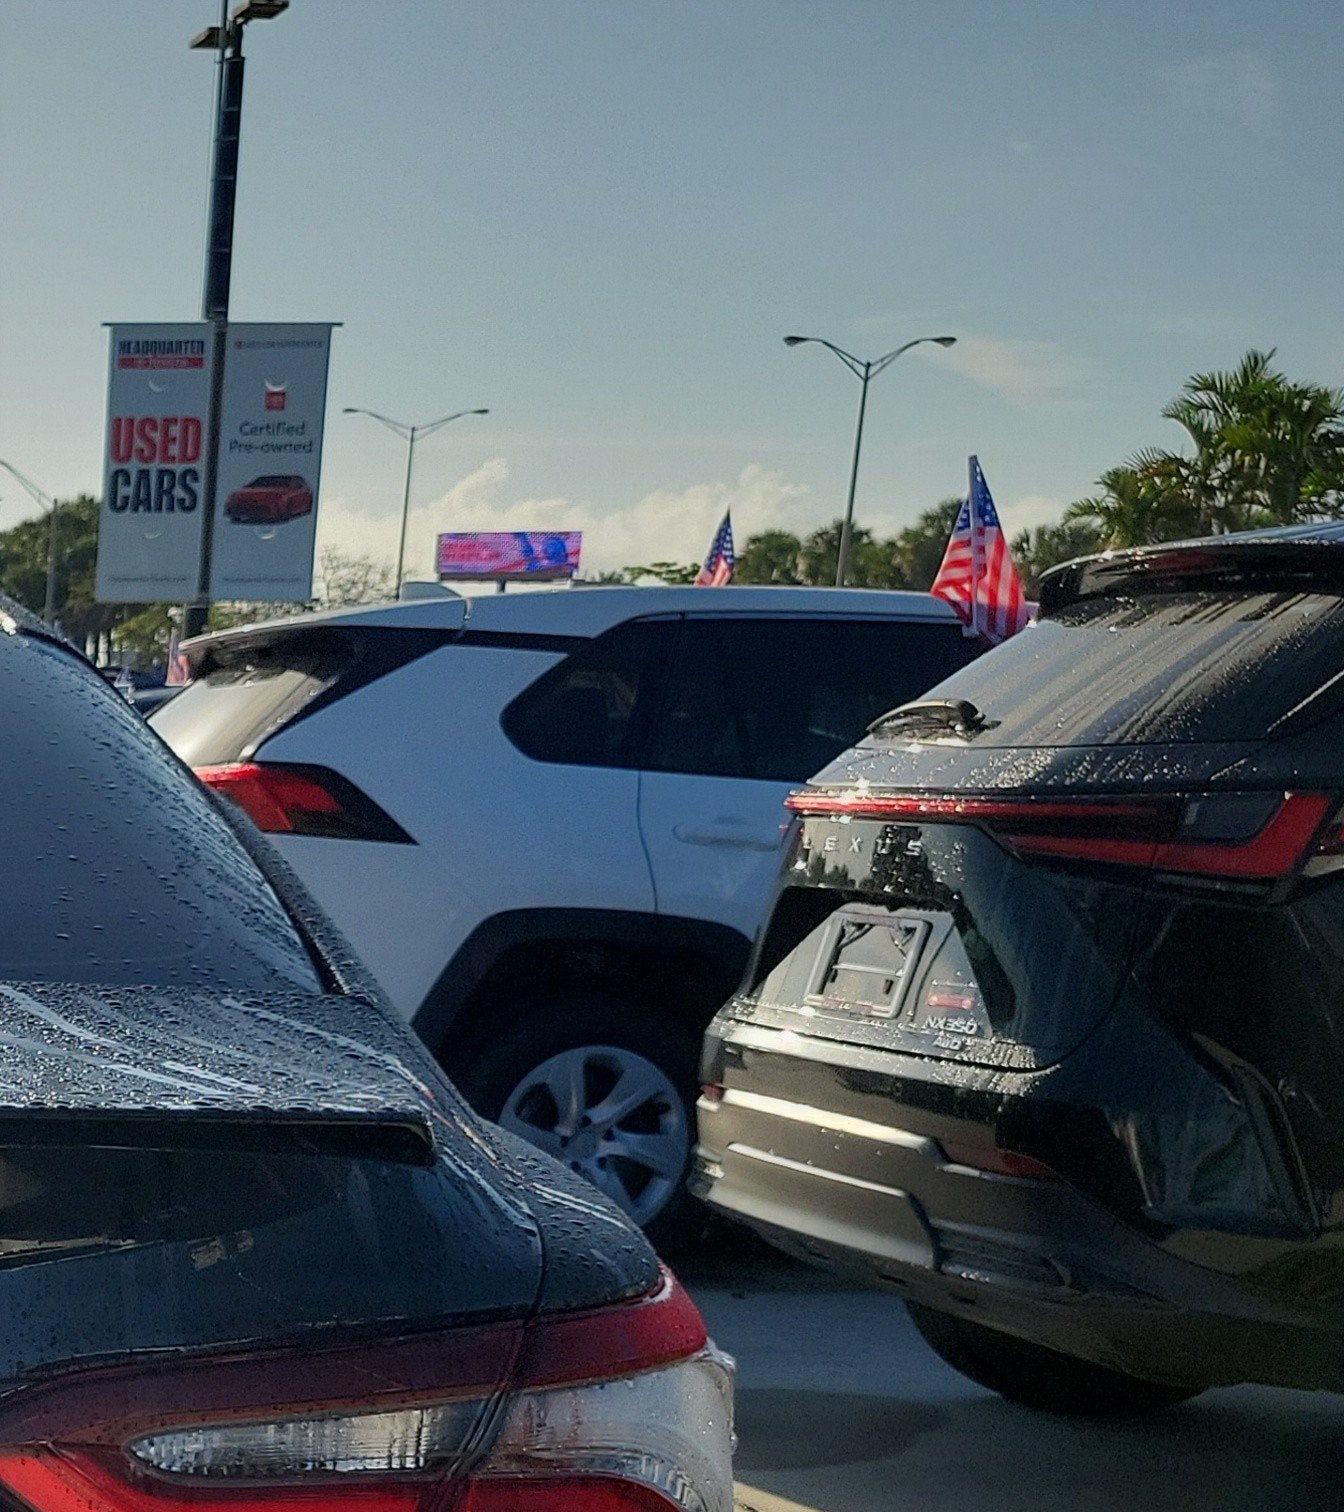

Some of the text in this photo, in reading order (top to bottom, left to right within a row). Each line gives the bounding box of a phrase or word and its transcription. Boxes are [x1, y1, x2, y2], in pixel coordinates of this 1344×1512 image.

[238, 420, 306, 437] Certified
[112, 417, 202, 464] USED
[229, 440, 313, 455] Pre-owned
[111, 468, 200, 514] CARS
[803, 836, 922, 856] LEXUS
